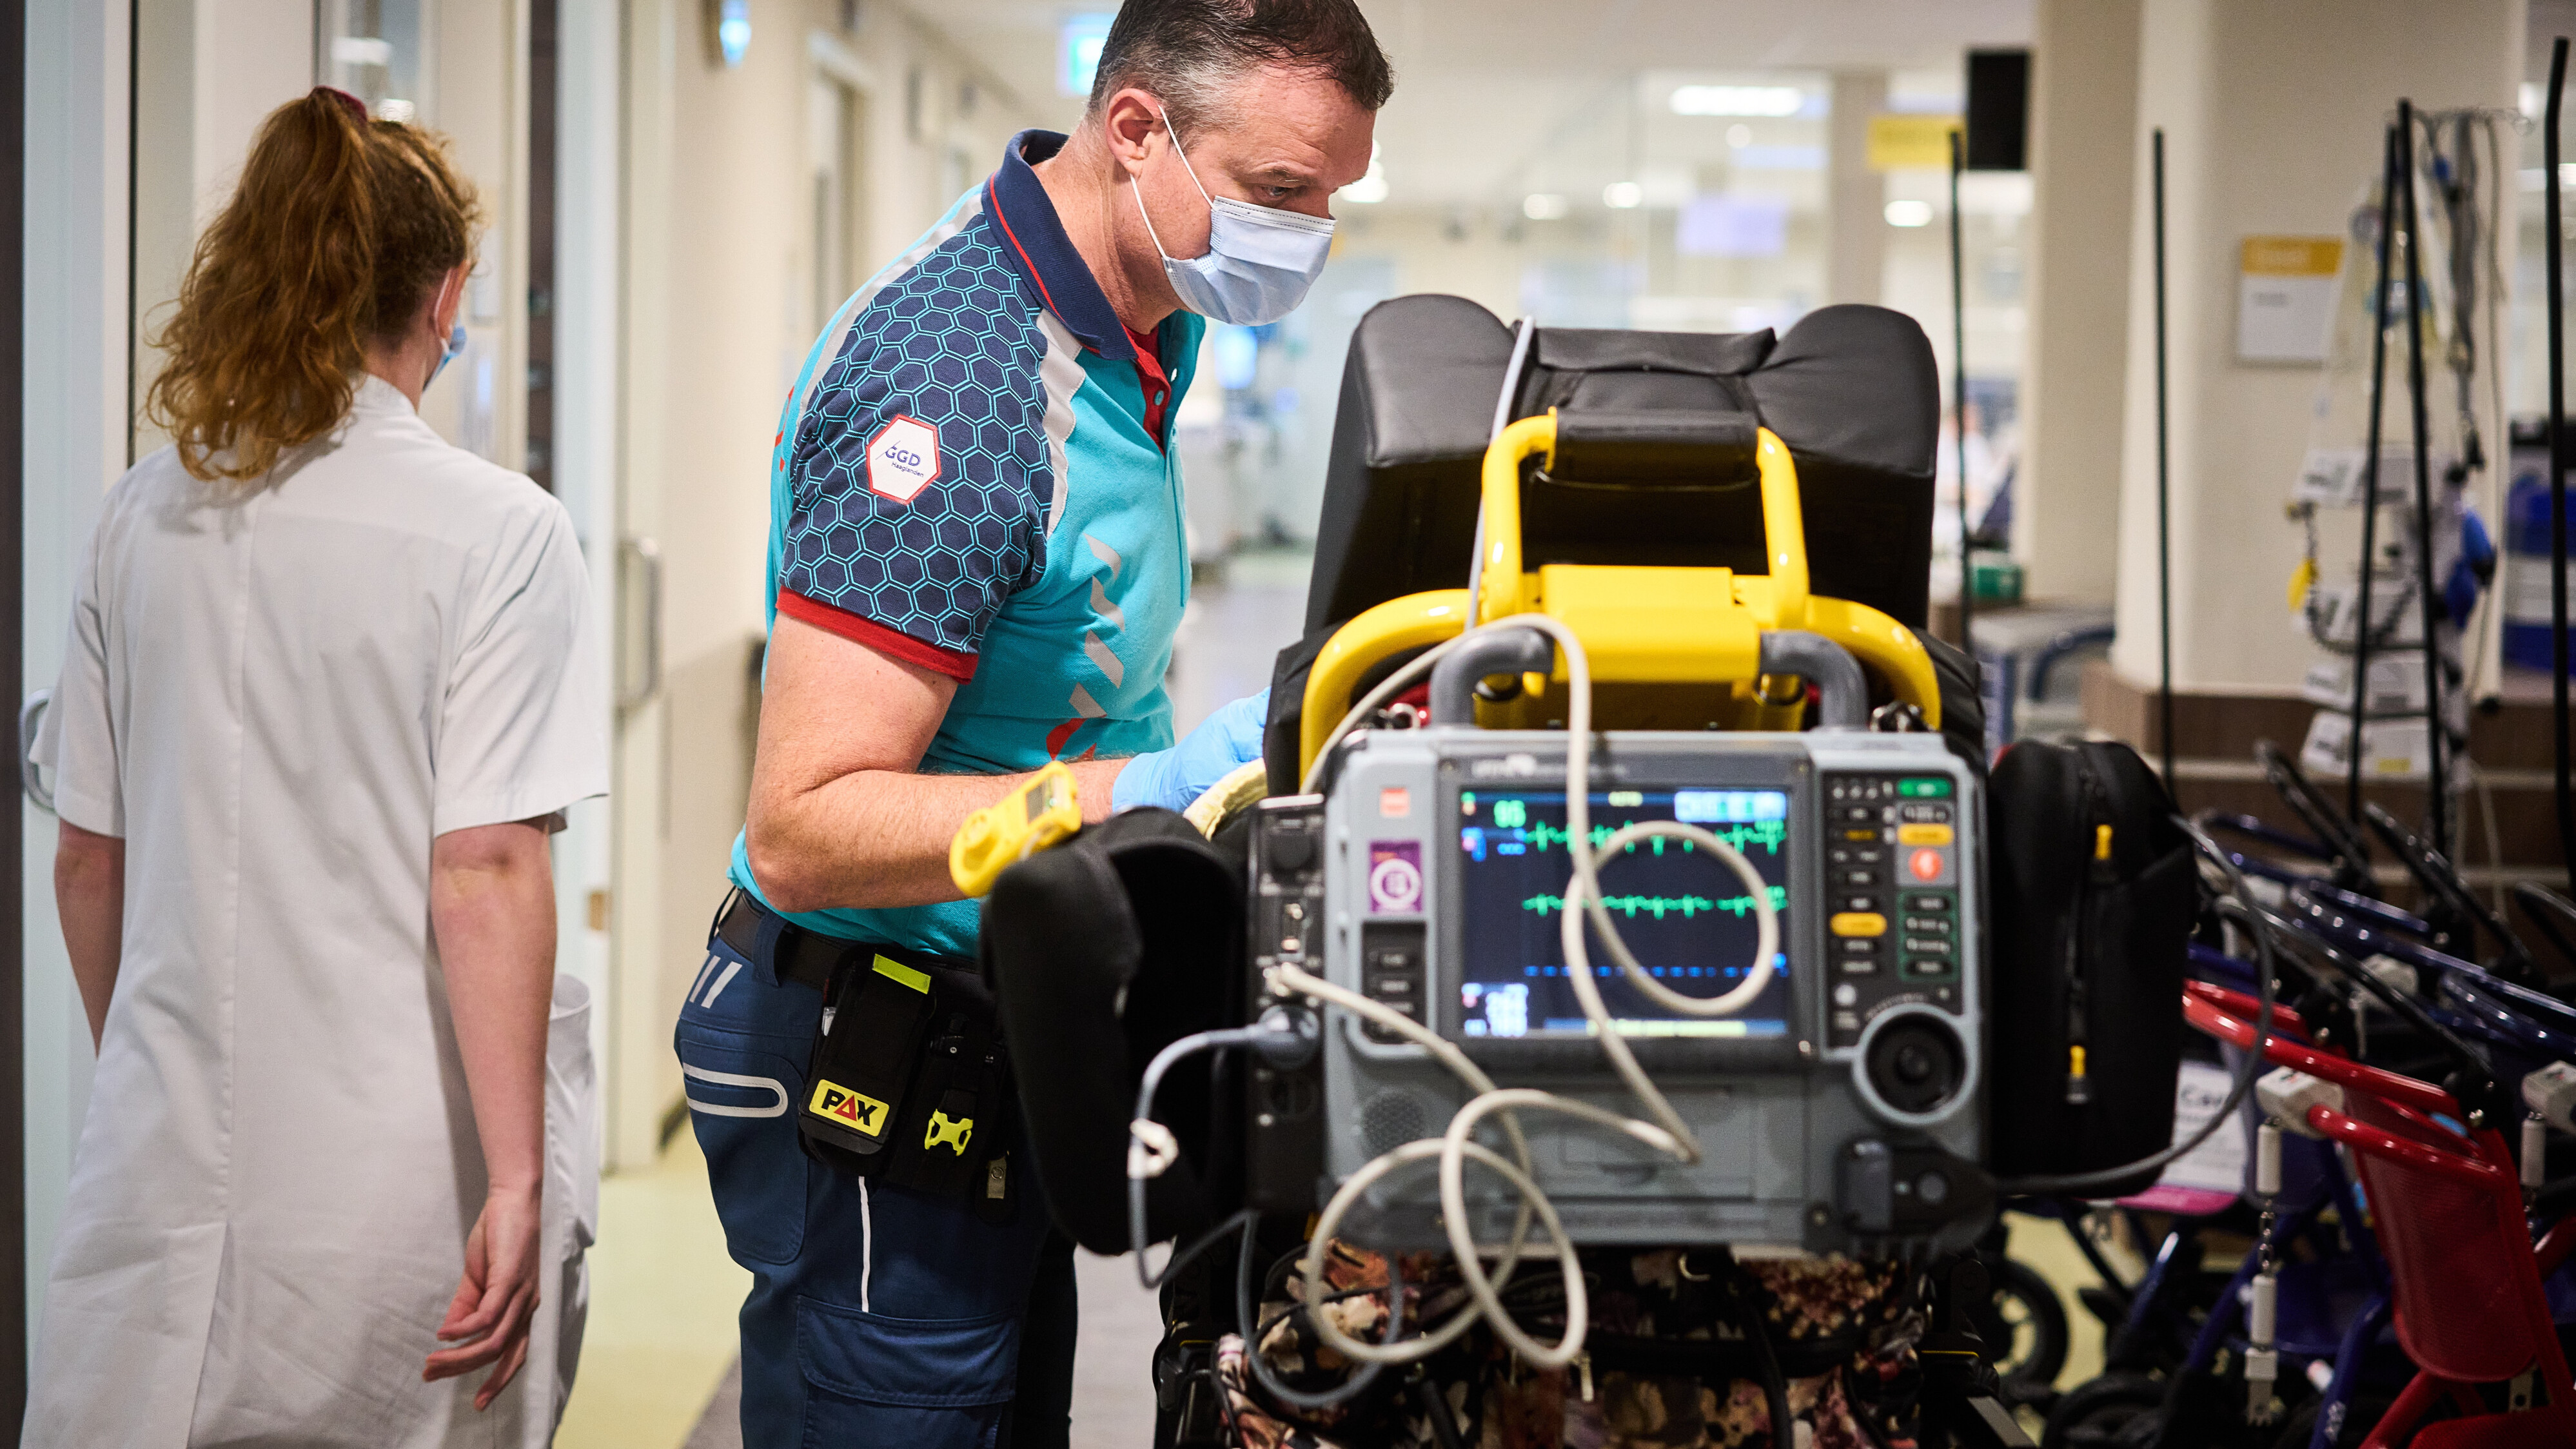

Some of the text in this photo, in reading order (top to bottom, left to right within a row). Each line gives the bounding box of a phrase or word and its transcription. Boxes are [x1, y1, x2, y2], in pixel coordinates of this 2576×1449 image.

[885, 446, 921, 466] GGD
[891, 462, 924, 478] Haaglanden
[821, 1088, 878, 1127] PAX
